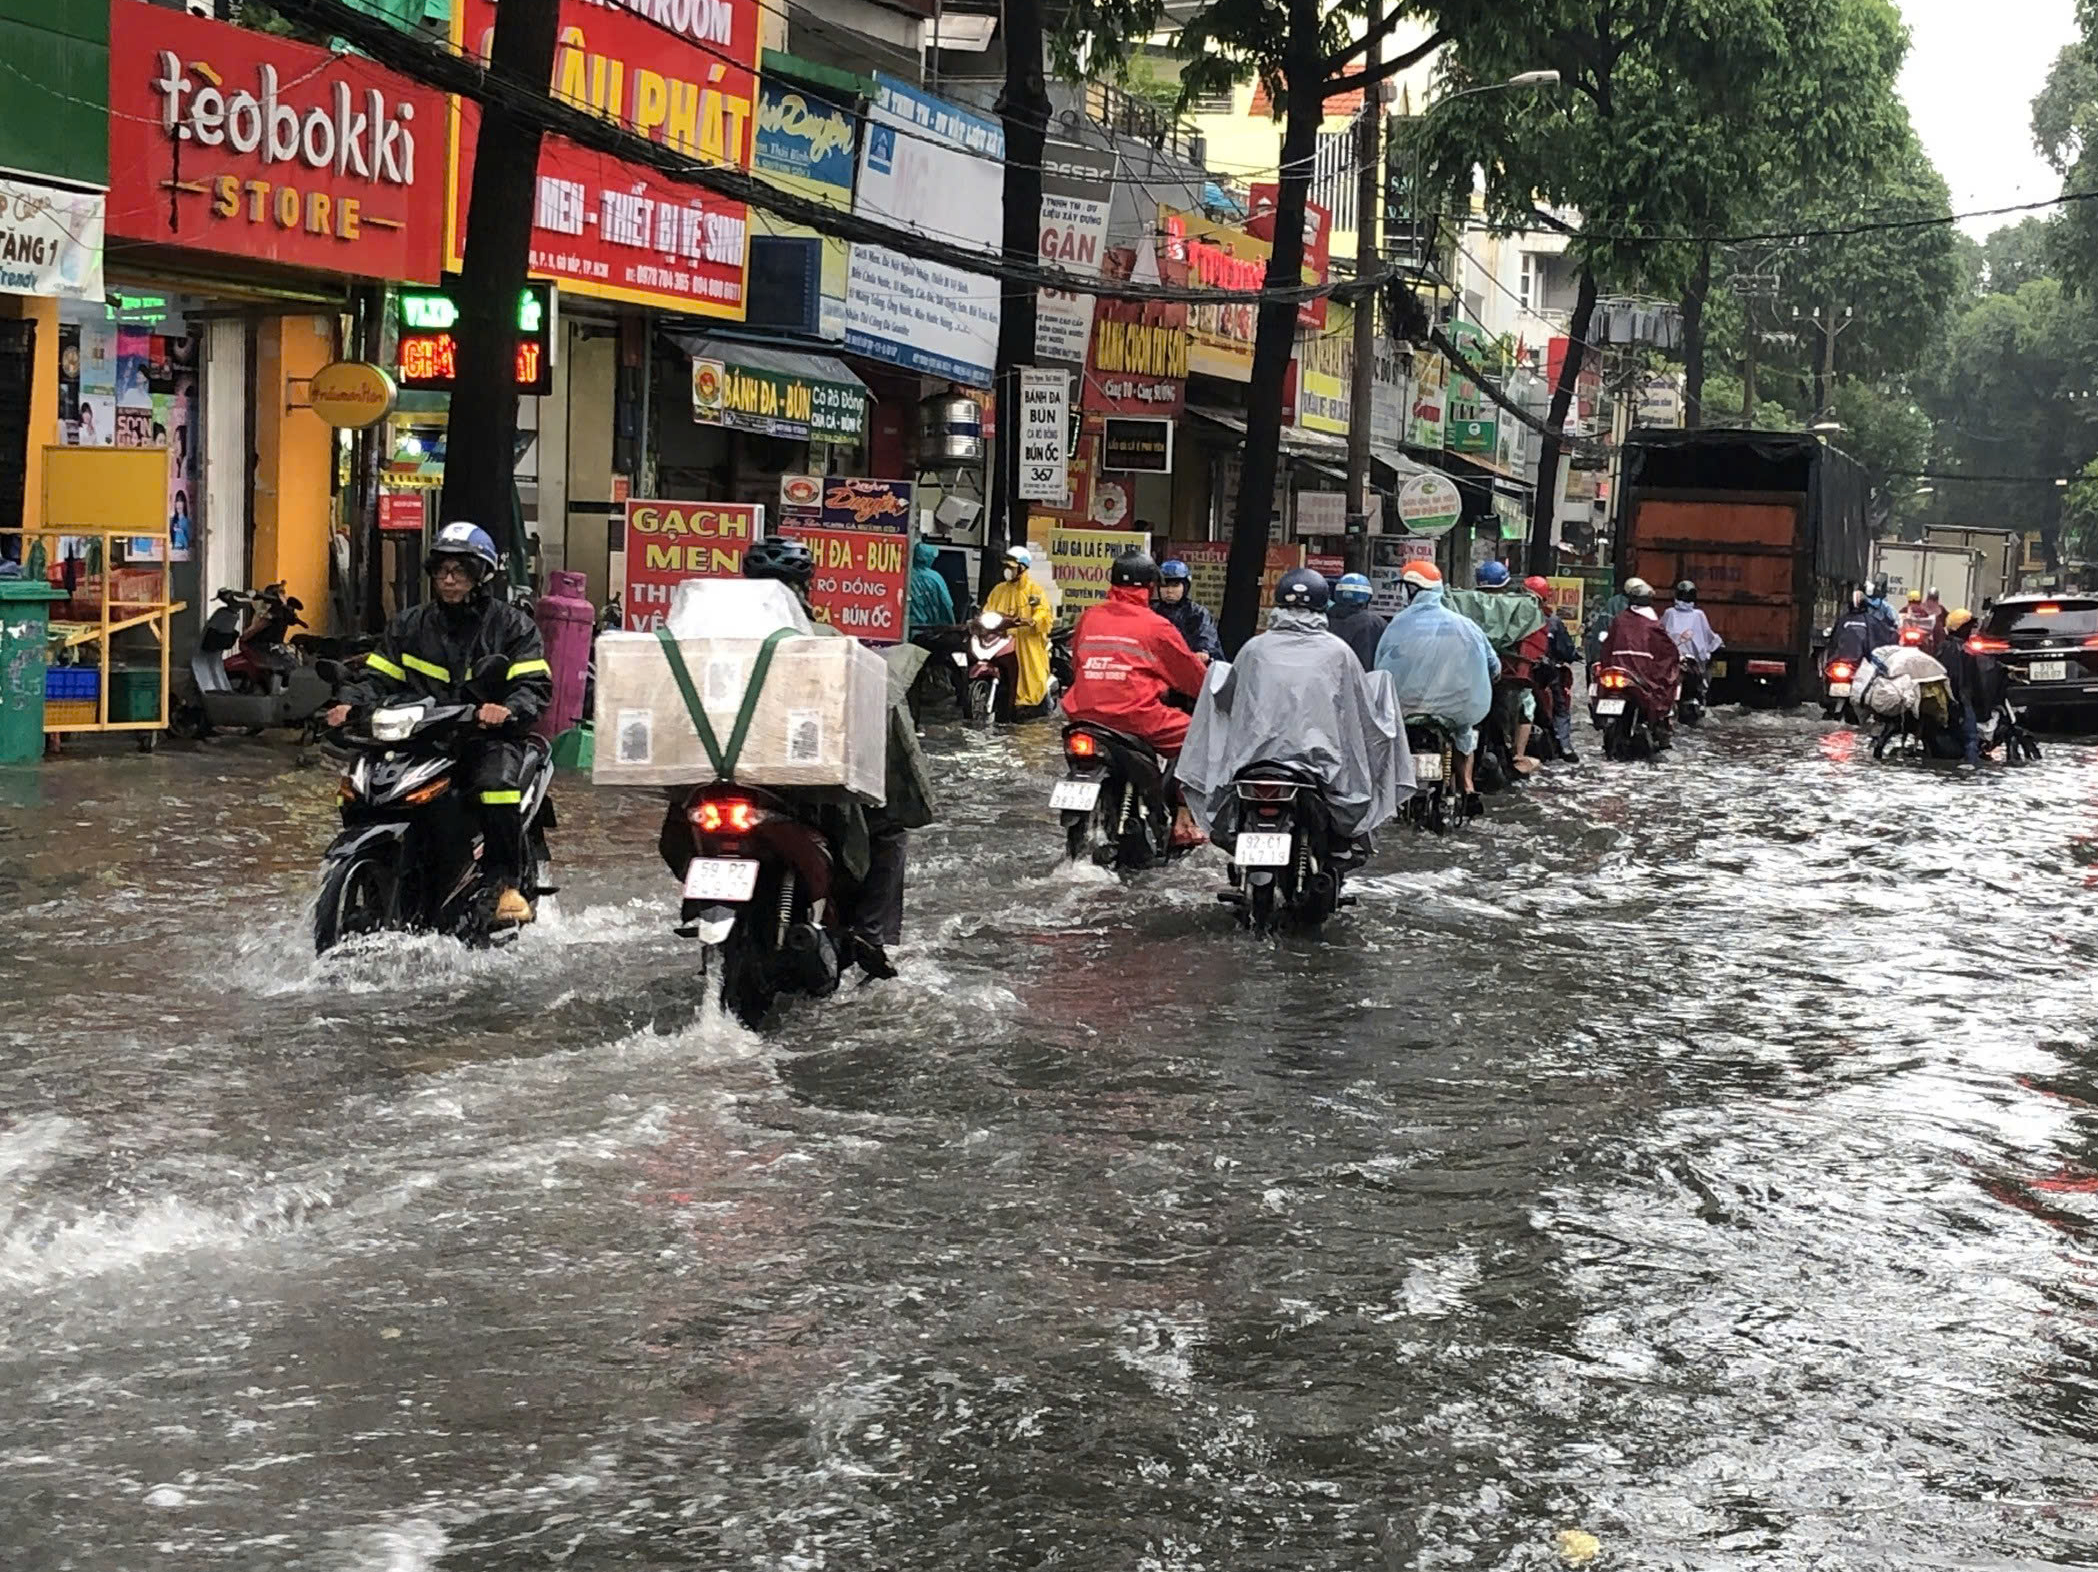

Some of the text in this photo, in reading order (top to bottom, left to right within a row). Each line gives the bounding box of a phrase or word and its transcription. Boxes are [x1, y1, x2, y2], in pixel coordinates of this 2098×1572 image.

[632, 63, 750, 165] PHÁT
[212, 176, 361, 240] STORE
[536, 176, 585, 236] MEN
[600, 181, 655, 249] THIẾT
[655, 202, 680, 265] BỊ
[679, 198, 704, 270] VỆ
[703, 211, 746, 268] SINH
[724, 366, 758, 412] BÁNH
[760, 379, 779, 417] ĐA
[785, 379, 811, 421] BÚN
[1025, 388, 1047, 404] BÁNH
[1030, 406, 1056, 423] BÚN
[1025, 442, 1043, 461] BÚN
[1030, 467, 1054, 482] 367
[632, 507, 748, 541] GẠCH
[645, 544, 742, 574] MEN
[828, 539, 853, 569] ĐA
[866, 537, 903, 574] BÚN
[841, 603, 868, 626] BÚN
[870, 604, 892, 628] ỐC
